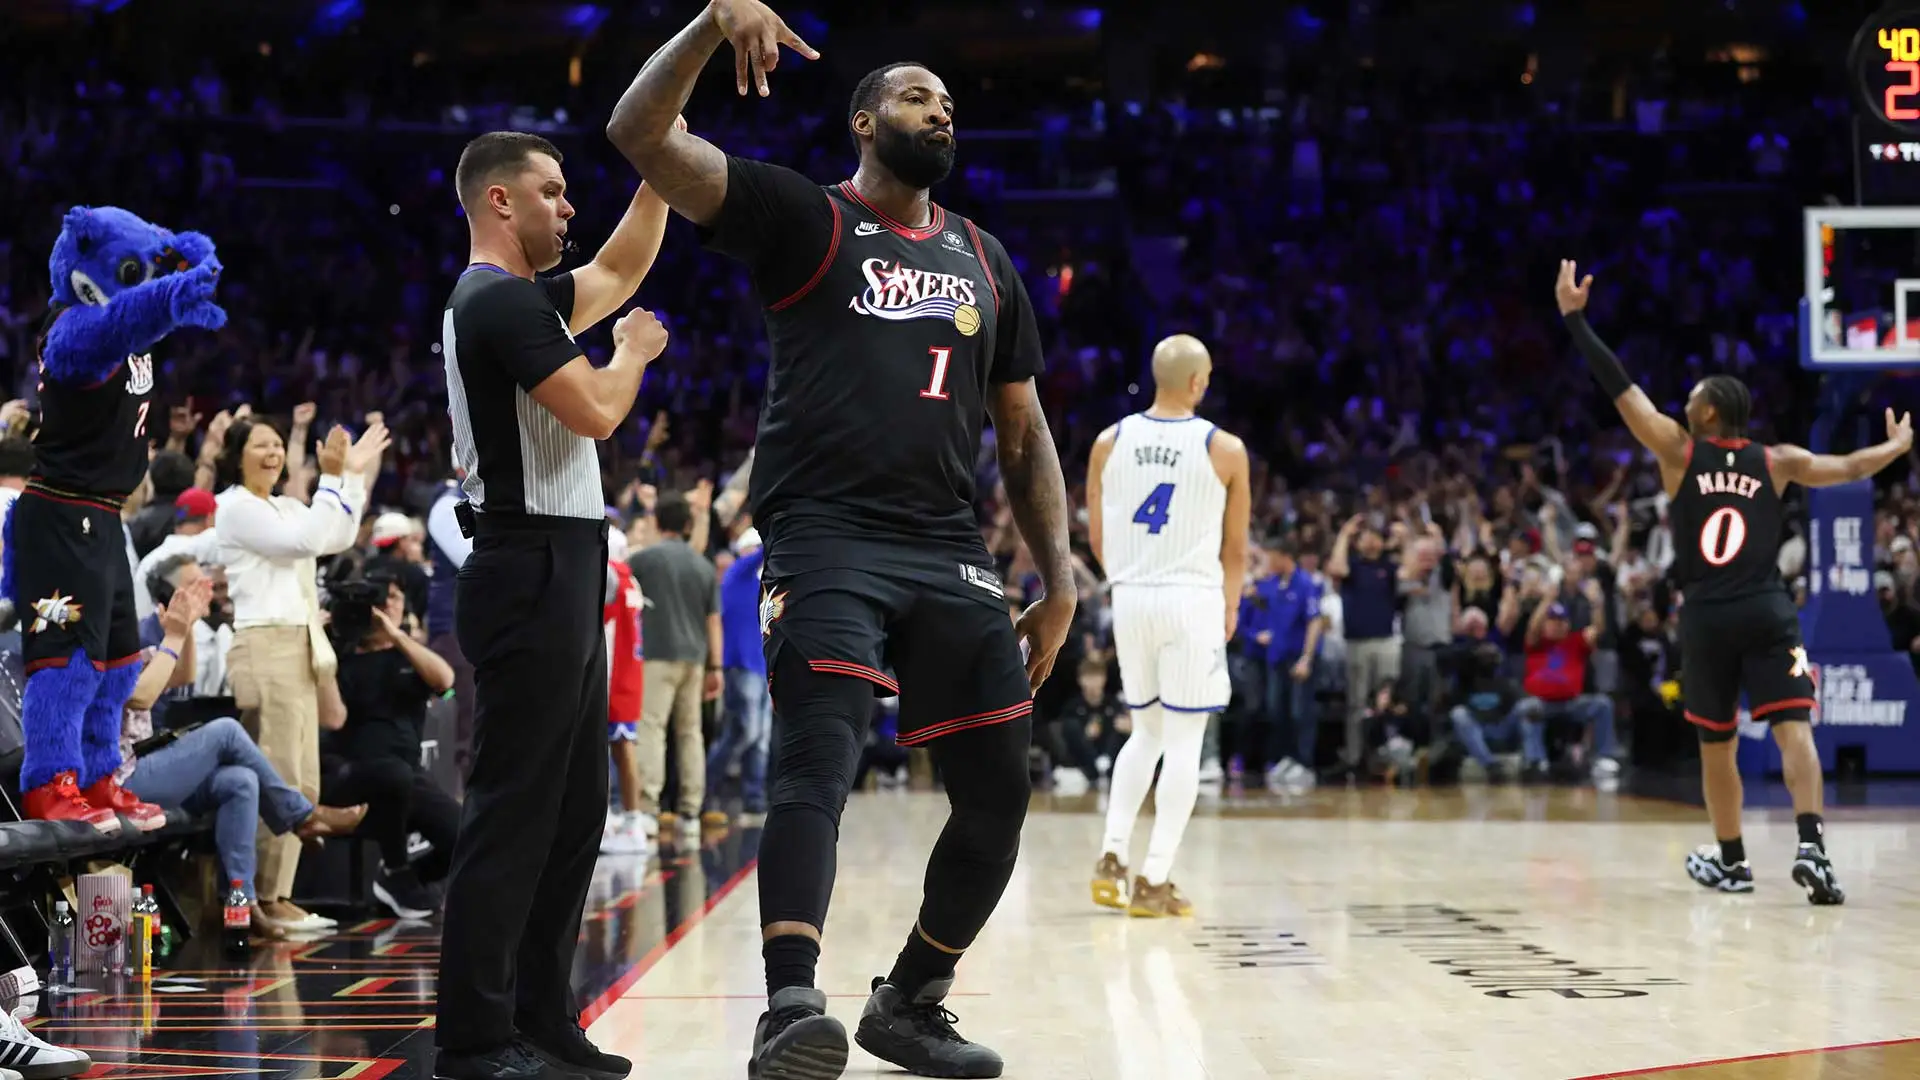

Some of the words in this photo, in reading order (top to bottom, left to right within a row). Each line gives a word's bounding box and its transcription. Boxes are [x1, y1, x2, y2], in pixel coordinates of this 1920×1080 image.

[858, 221, 881, 232] NIKE
[919, 346, 953, 401] 1
[1134, 446, 1182, 468] SUGGS
[1696, 471, 1762, 499] MAXEY
[1132, 483, 1176, 534] 4
[1699, 504, 1747, 568] 0
[87, 914, 112, 933] POP
[1401, 943, 1689, 999] mobile
